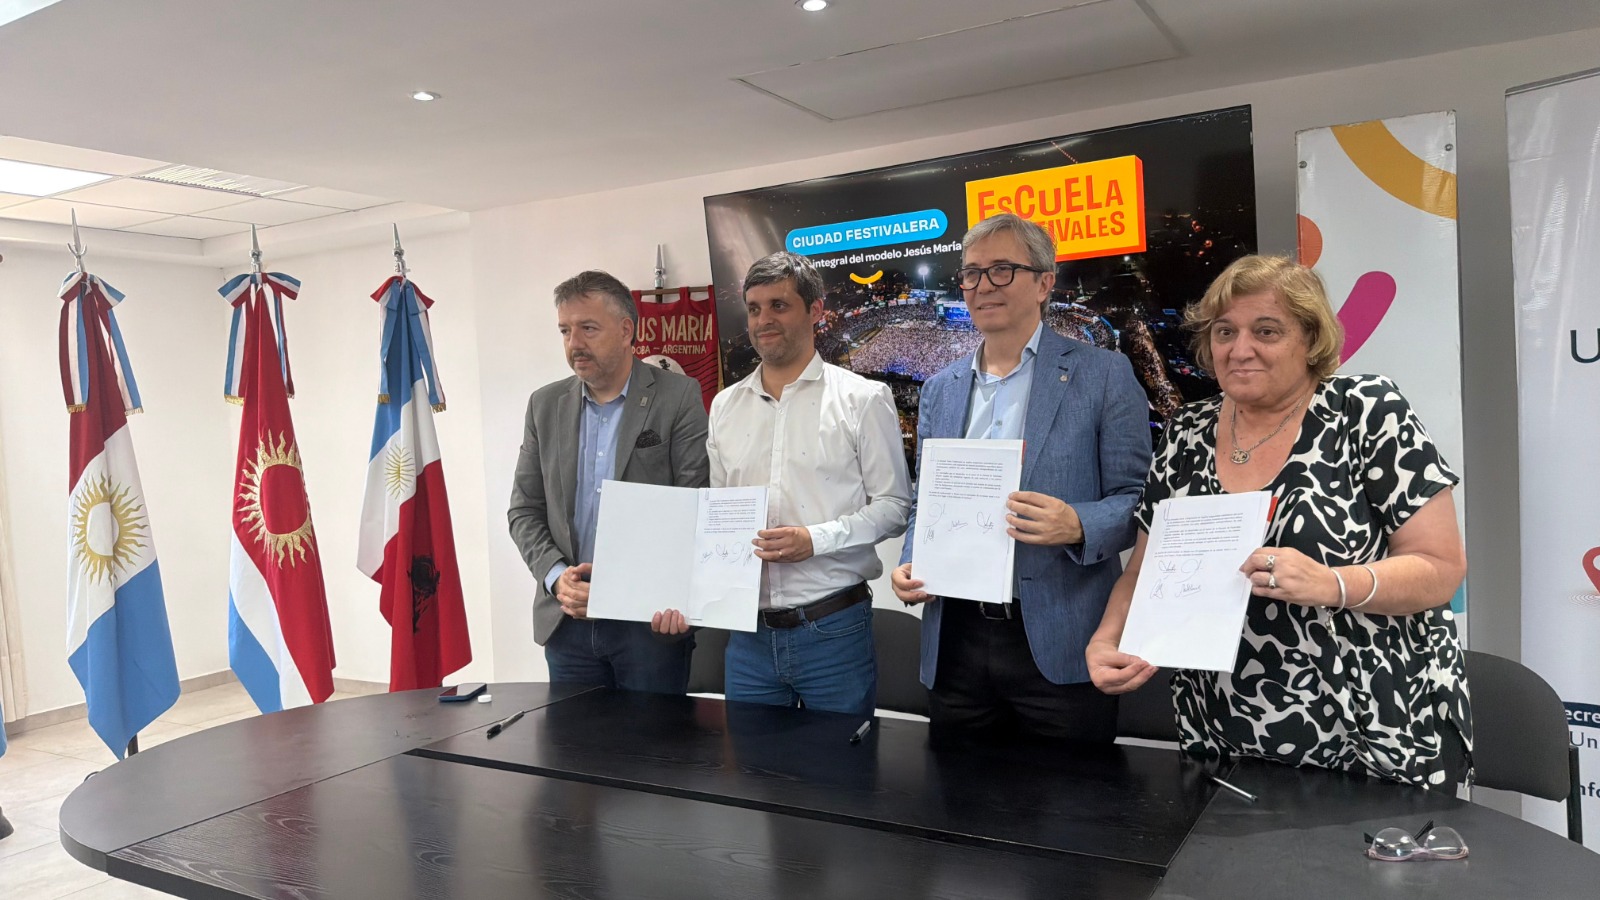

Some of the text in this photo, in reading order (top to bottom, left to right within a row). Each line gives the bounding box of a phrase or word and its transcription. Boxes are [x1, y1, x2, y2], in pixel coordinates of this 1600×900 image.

[977, 174, 1124, 221] ESCUELA
[792, 217, 940, 249] CIUDAD FESTIVALERA
[812, 240, 962, 269] integral del modelo Jesús María
[660, 313, 713, 342] MARIA
[661, 344, 707, 355] ARGENTINA
[1570, 731, 1598, 749] Un
